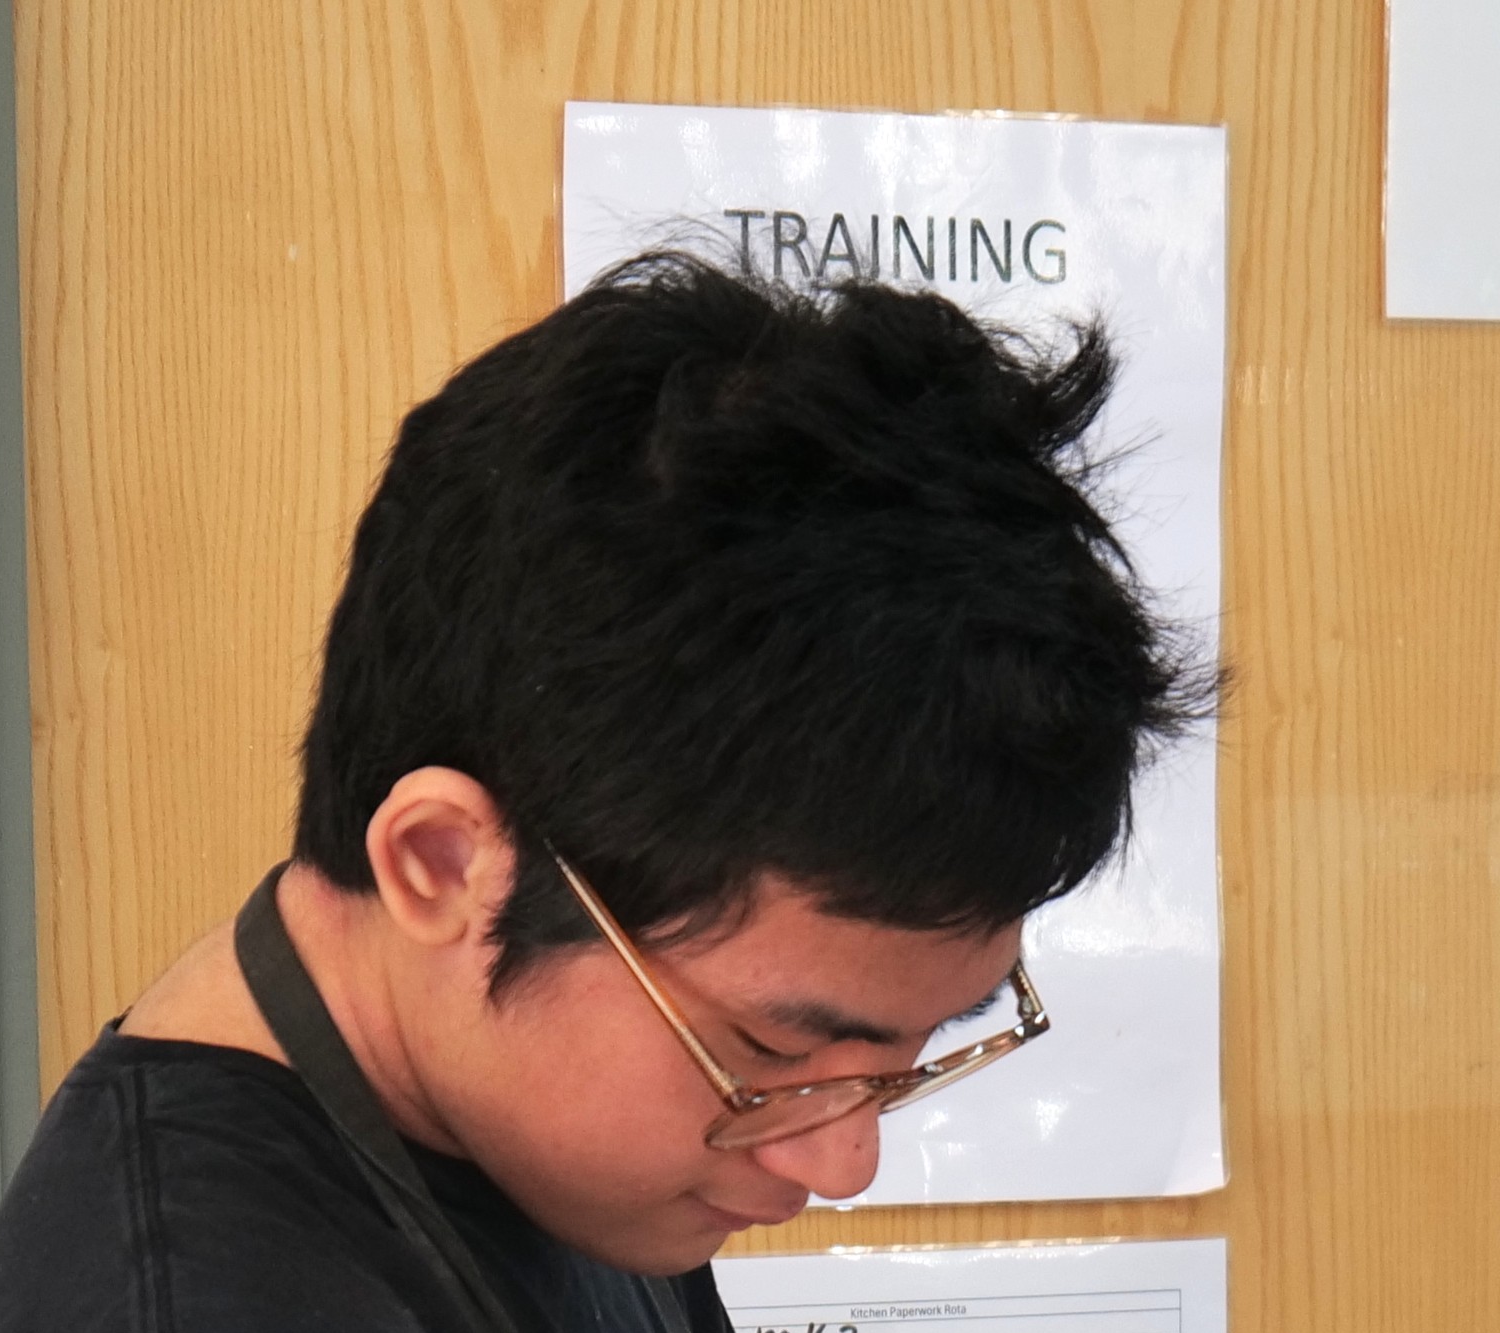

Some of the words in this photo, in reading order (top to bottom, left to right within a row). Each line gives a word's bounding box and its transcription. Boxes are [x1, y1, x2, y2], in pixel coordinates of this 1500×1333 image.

[725, 208, 1069, 286] TRAINING
[850, 1307, 888, 1320] Kitchen
[890, 1306, 942, 1319] Paperwork
[944, 1305, 967, 1316] Rota
